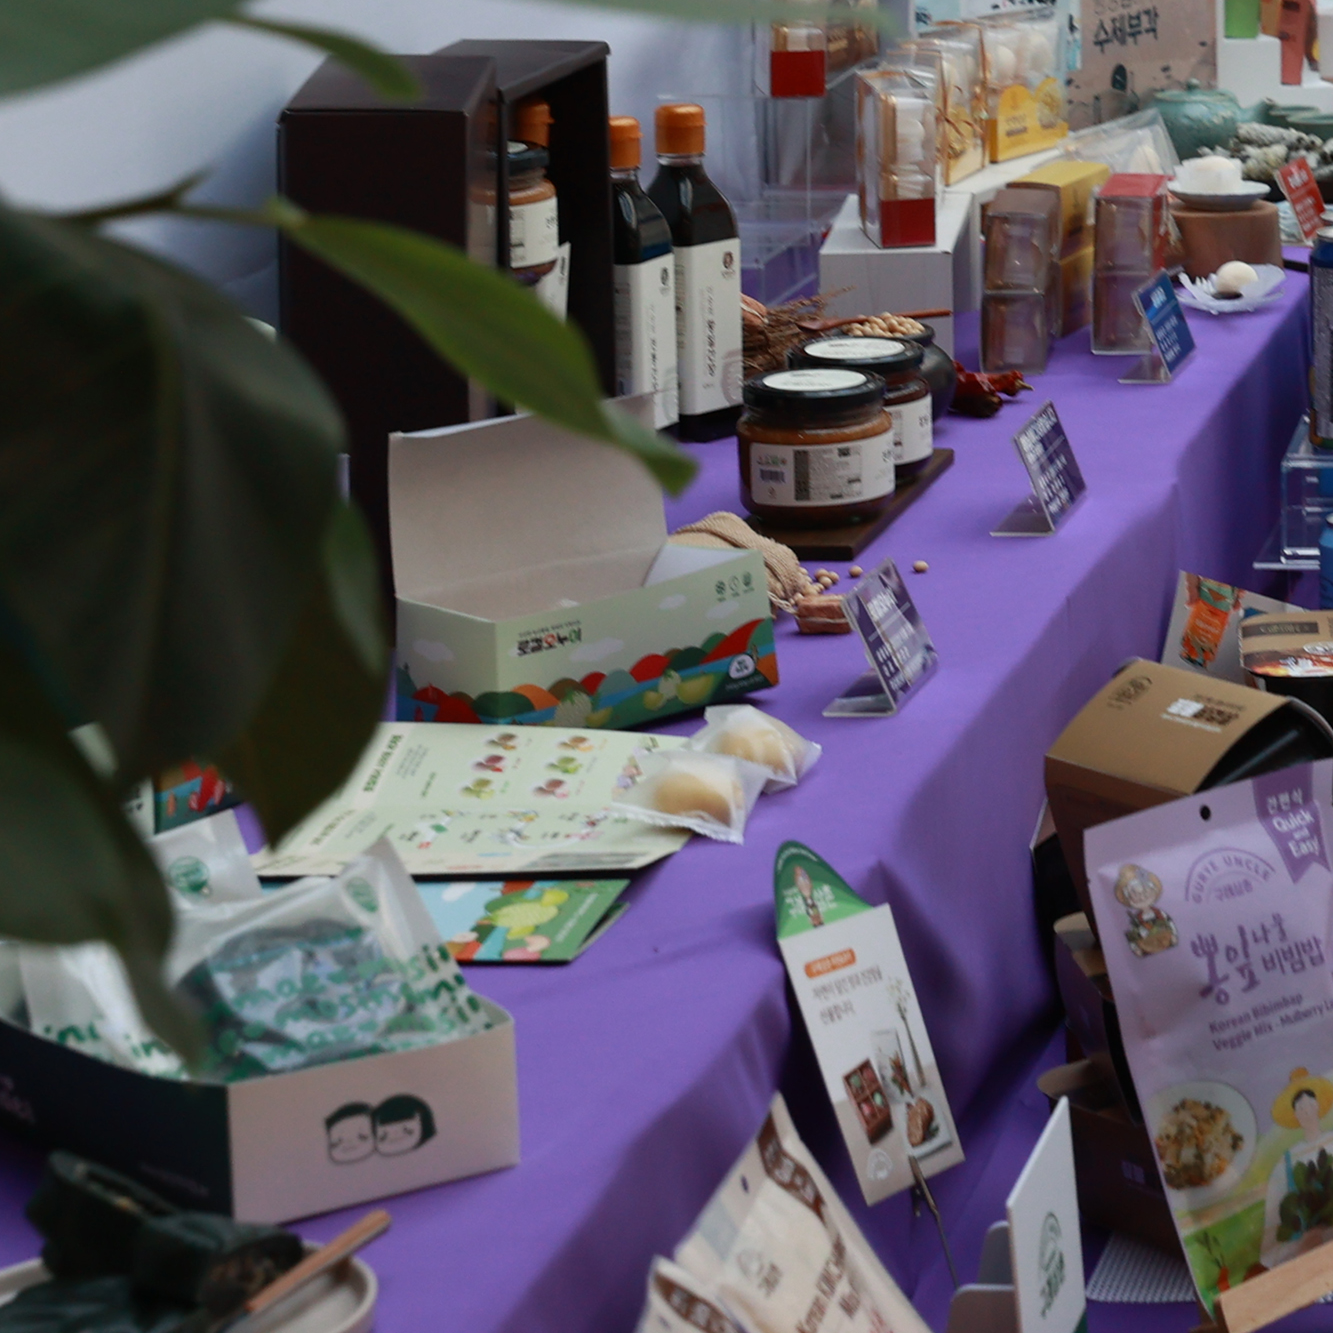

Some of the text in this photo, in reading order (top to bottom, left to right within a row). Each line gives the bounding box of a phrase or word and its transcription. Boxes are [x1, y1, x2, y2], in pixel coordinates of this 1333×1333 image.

[1093, 5, 1160, 54] 수제부각
[1266, 787, 1304, 815] 간편식
[1272, 809, 1315, 833] Quick
[1288, 836, 1321, 859] Easy
[1191, 853, 1271, 904] GURYE UNCLE
[1190, 912, 1287, 1005] 뽕잎 나물
[1261, 935, 1325, 975] 비빔밥
[1208, 992, 1304, 1034] Korean Bibimbap
[1212, 1028, 1253, 1051] Veggie
[1253, 1022, 1274, 1037] Mix
[1279, 1005, 1323, 1028] Mulberry
